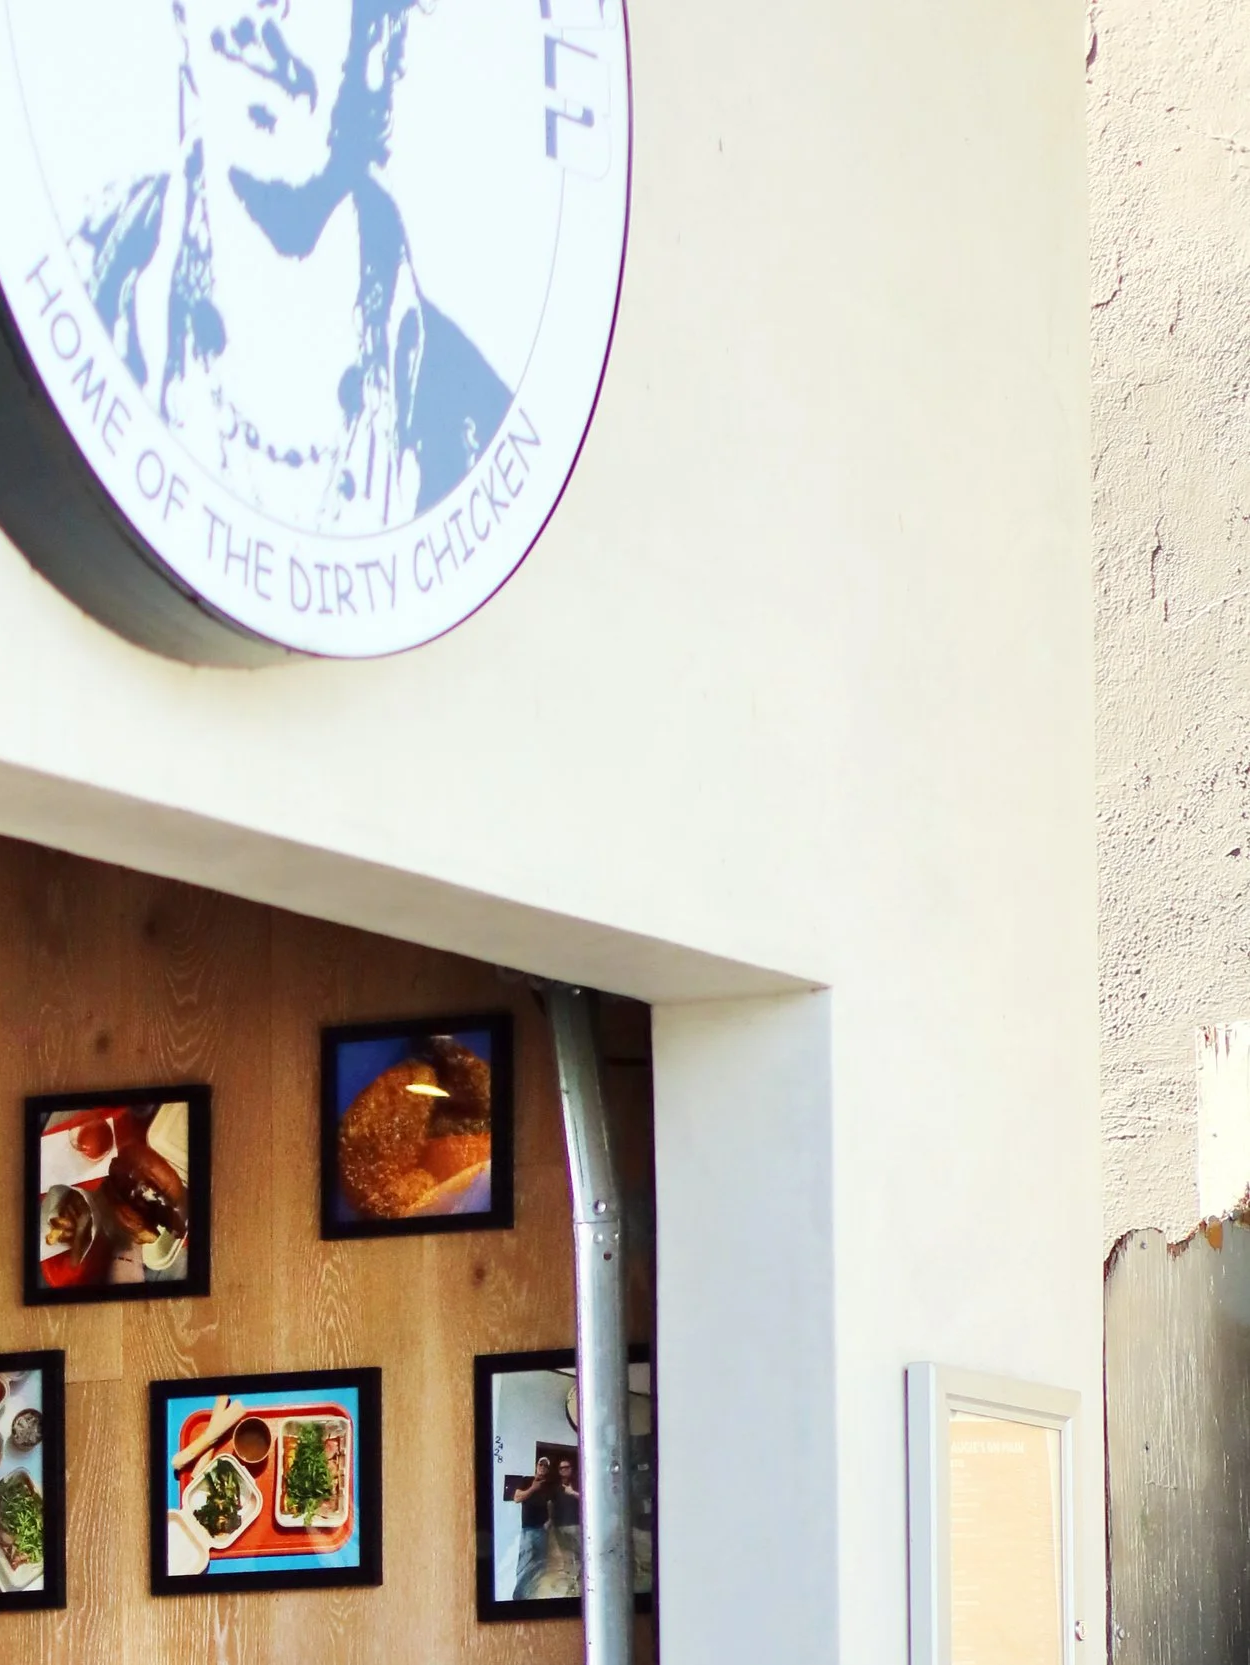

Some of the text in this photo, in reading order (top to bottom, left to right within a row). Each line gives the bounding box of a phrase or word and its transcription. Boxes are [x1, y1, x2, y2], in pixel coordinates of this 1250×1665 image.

[25, 254, 543, 617] HOME OF THE DIRTY CHICKEN
